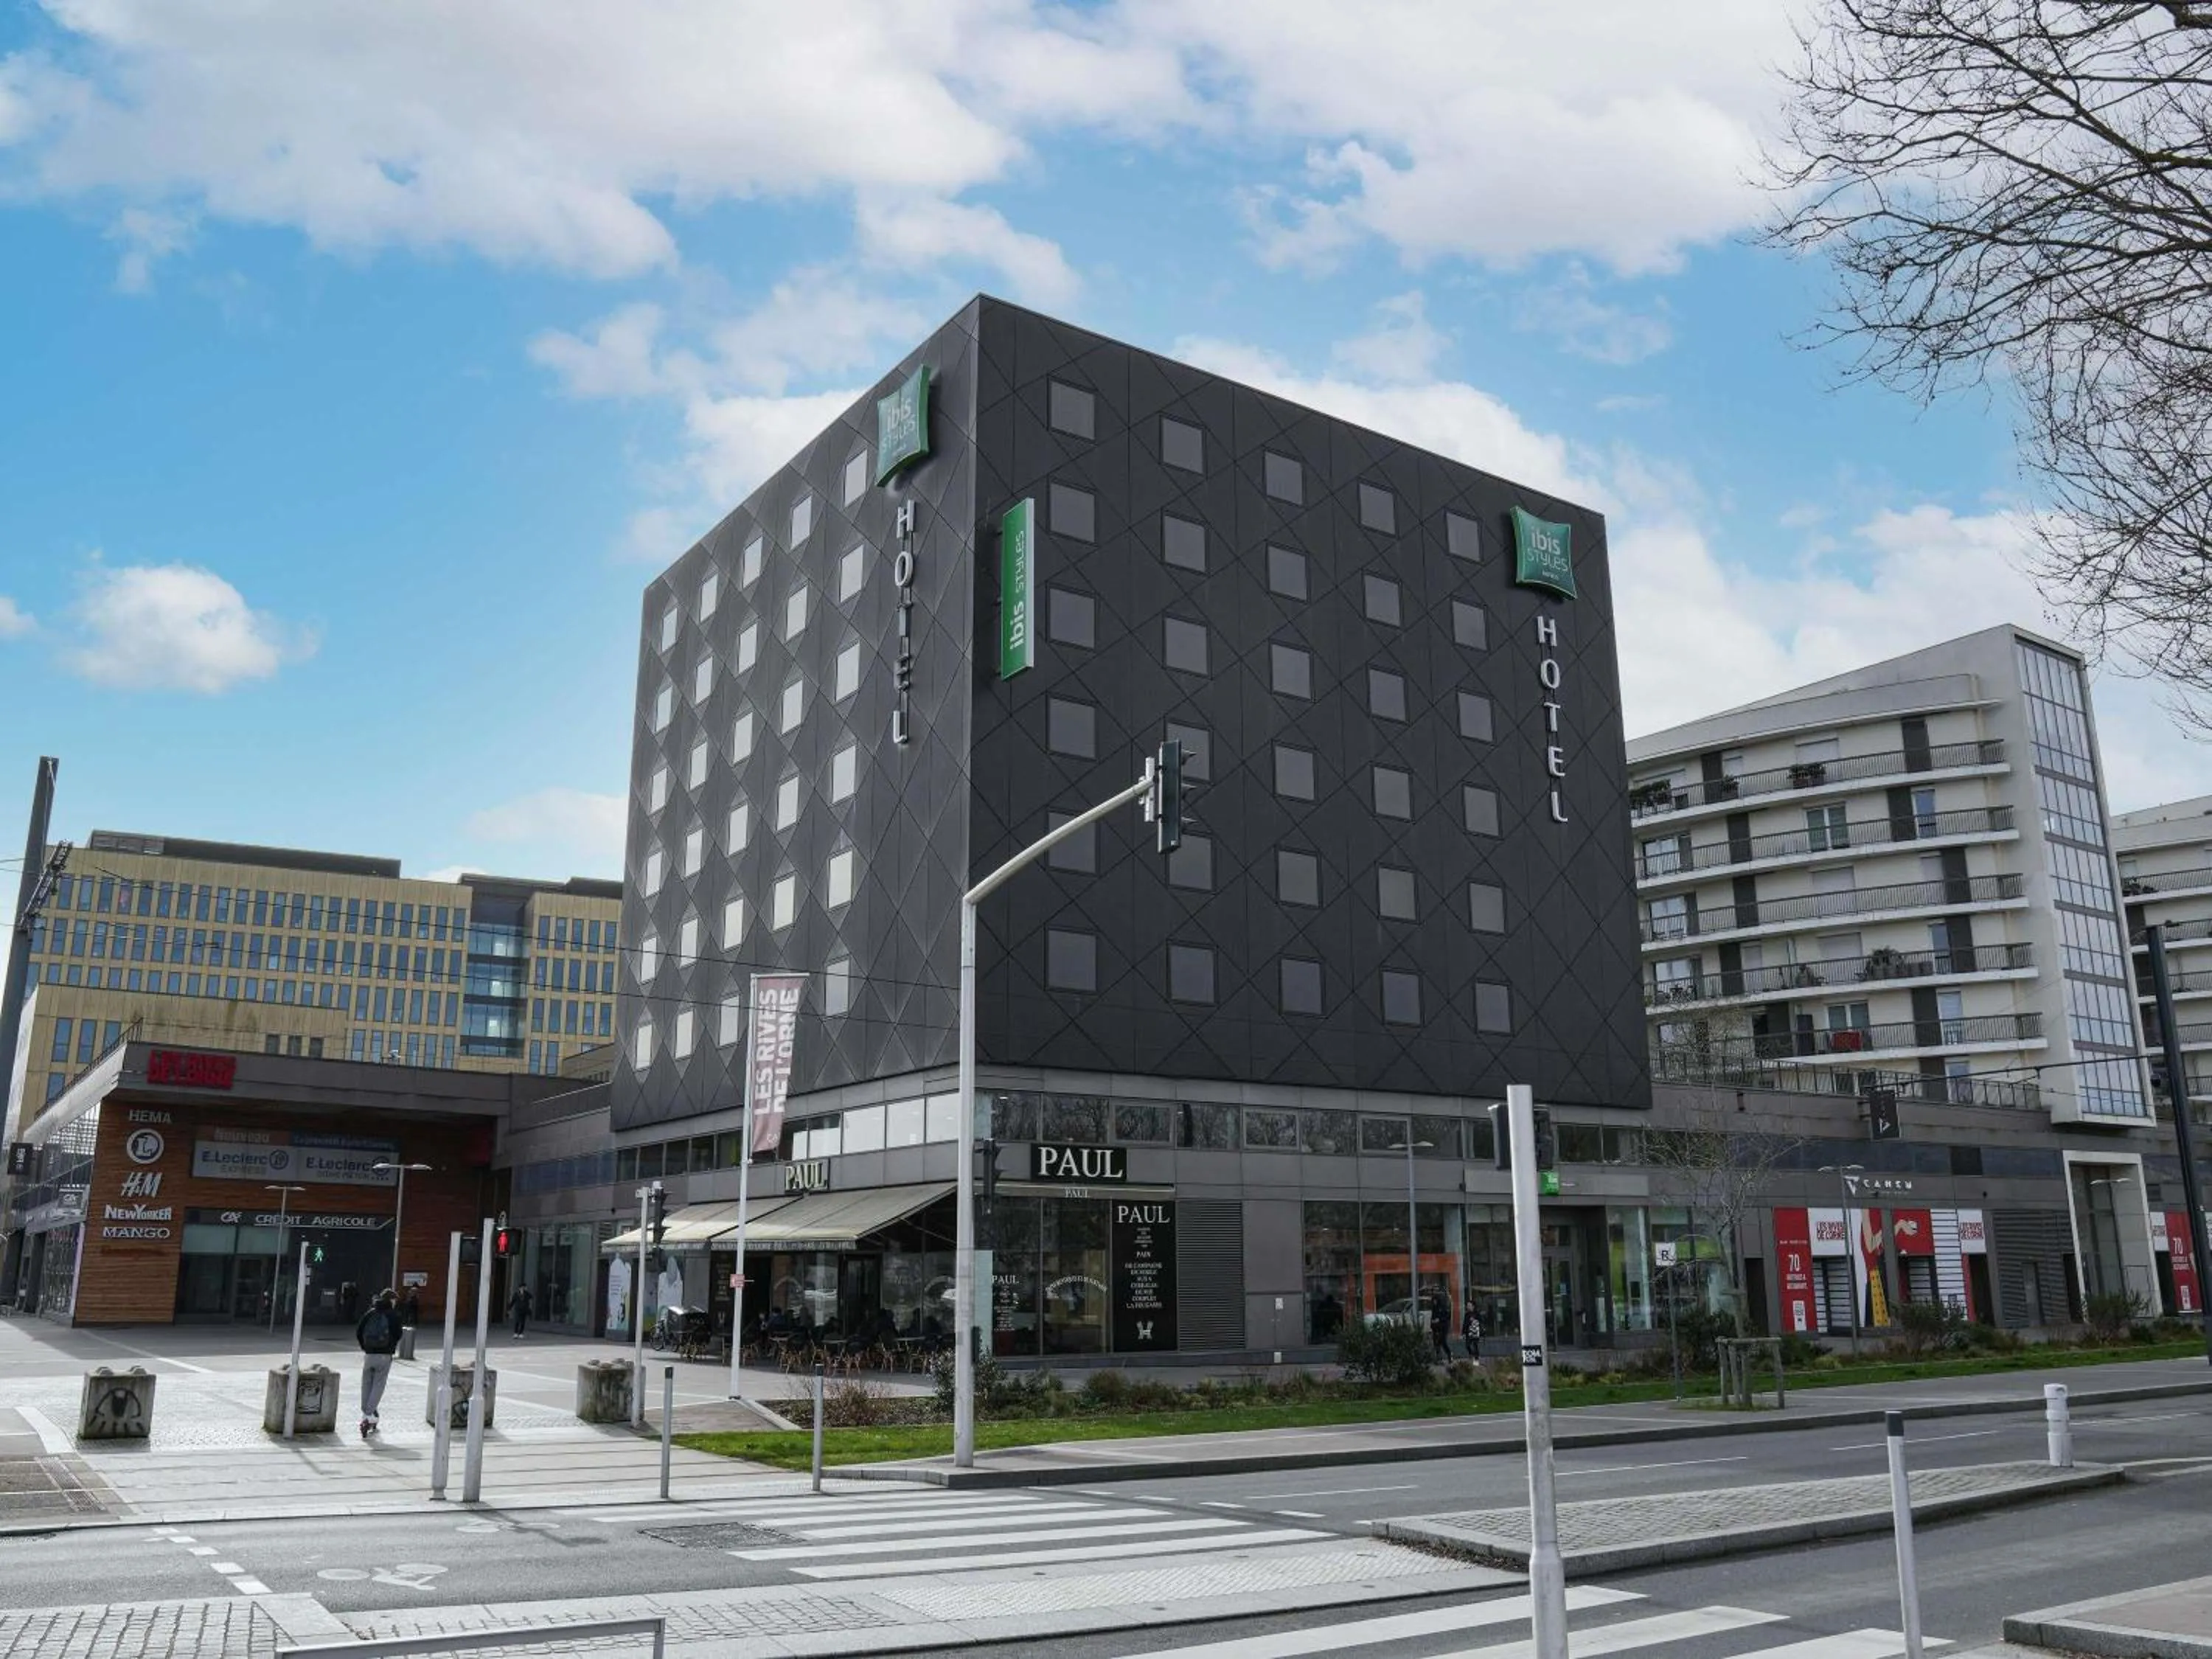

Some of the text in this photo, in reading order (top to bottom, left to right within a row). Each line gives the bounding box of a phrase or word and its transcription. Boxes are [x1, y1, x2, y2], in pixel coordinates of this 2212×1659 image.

[887, 397, 911, 434] ibis
[1531, 526, 1561, 555] ibis
[1526, 548, 1568, 571] STYLES
[893, 498, 915, 744] HOTEL
[1009, 601, 1024, 650] ibis
[1537, 616, 1568, 823] HOTEL
[756, 989, 778, 1062] RIVES
[754, 1067, 773, 1116] LES
[129, 1109, 173, 1124] HEMA
[201, 1147, 268, 1165] E.Leclerc
[306, 1156, 371, 1172] E.Leclerc
[1037, 1147, 1123, 1178] PAUL
[121, 1171, 162, 1198] H&M
[785, 1162, 827, 1190] PAUL
[1064, 1187, 1091, 1198] PAUL
[311, 1216, 376, 1227] AGRICOLE
[1116, 1206, 1170, 1223] PAUL
[102, 1226, 170, 1239] MANGO
[1788, 1253, 1800, 1272] 70
[992, 1274, 1020, 1285] PAUL
